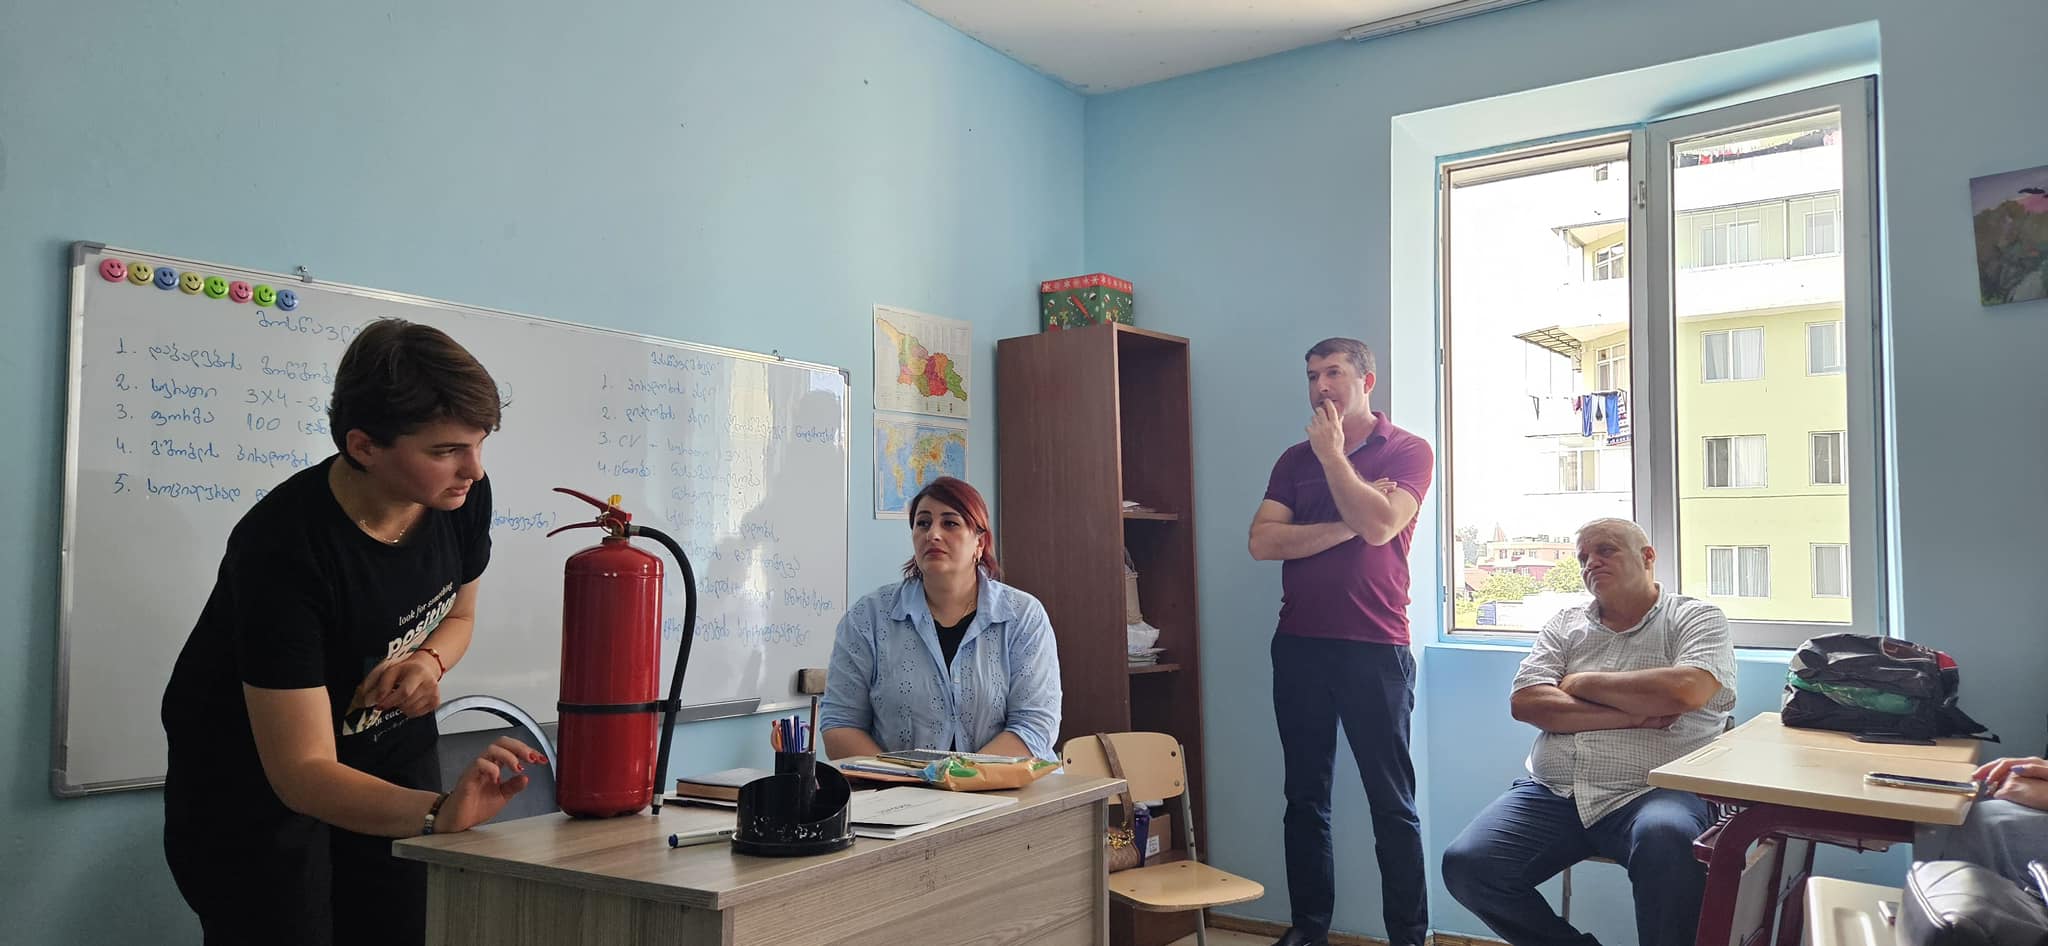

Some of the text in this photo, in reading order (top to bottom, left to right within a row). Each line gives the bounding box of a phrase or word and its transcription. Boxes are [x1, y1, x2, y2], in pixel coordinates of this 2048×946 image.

[116, 337, 137, 354] 1.
[261, 355, 336, 384] მოწმობ
[115, 373, 138, 391] 2.
[116, 404, 133, 420] 3.
[247, 413, 281, 431] 100
[399, 609, 416, 626] look
